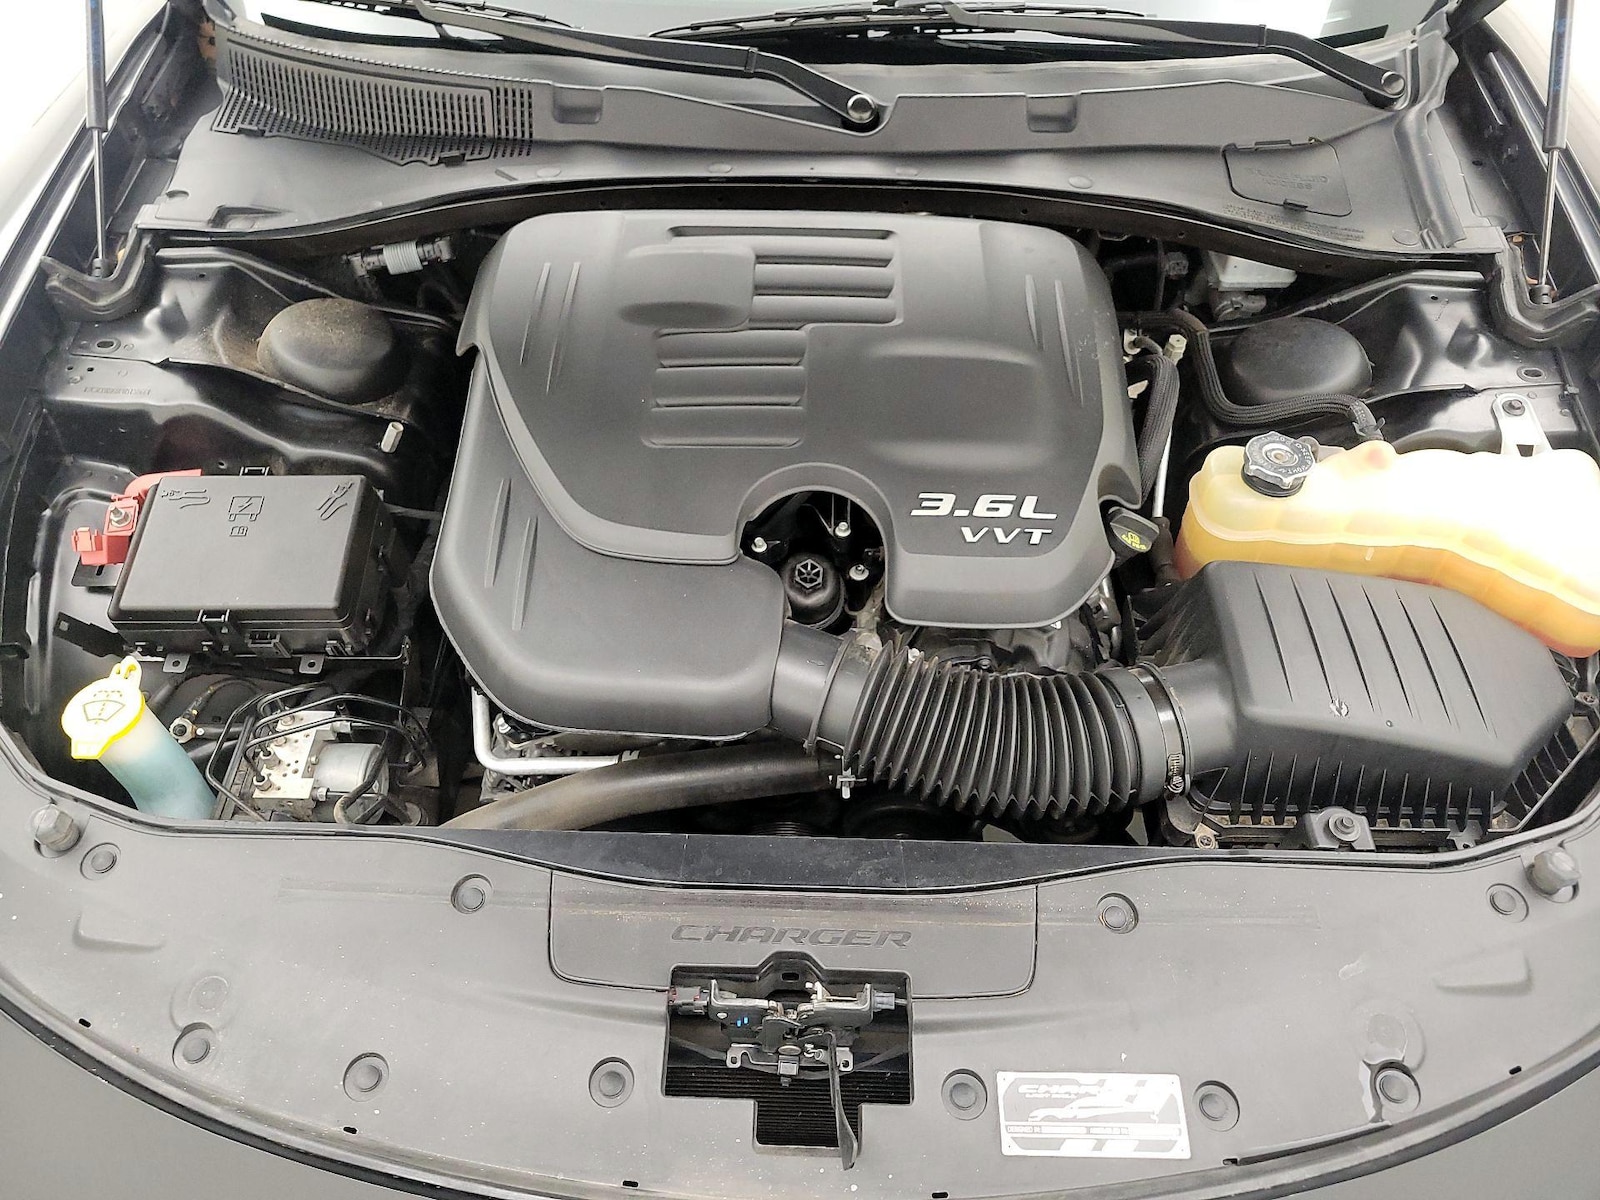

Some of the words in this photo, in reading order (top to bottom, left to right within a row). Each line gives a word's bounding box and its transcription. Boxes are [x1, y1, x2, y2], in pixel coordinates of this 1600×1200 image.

[910, 492, 1058, 520] 3.6L
[960, 526, 1053, 545] VVT
[671, 924, 913, 947] CHARGER
